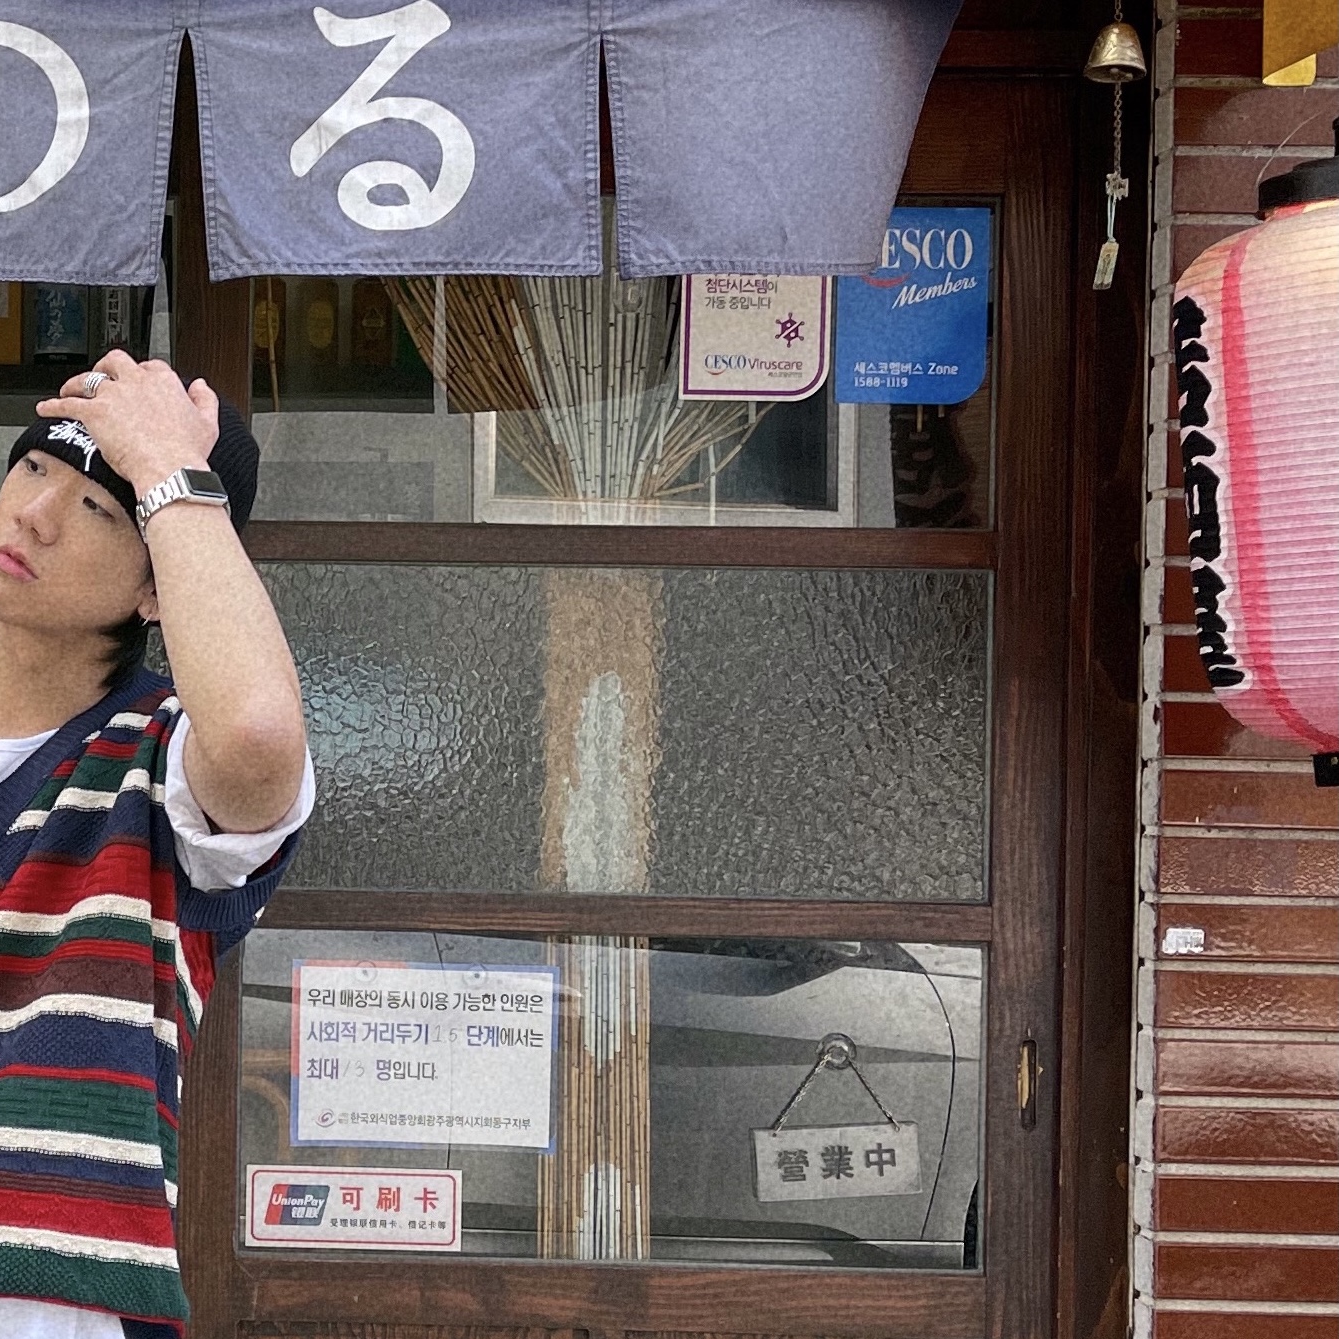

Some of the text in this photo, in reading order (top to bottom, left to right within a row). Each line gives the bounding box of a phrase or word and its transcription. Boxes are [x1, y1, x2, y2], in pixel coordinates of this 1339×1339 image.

[879, 228, 973, 269] ESCO
[705, 278, 778, 294] 첨단시스템이
[891, 272, 978, 309] Members
[704, 296, 771, 310] 가동 중입니다
[704, 354, 803, 371] CESCO Viruscare
[927, 362, 959, 375] Zone
[854, 376, 909, 388] 1588-1119
[307, 988, 544, 1014] 우리 매장의 동시 이용 가능한 인원은
[306, 1021, 357, 1044] 사회적
[361, 1022, 429, 1046] 거리두기
[466, 1025, 544, 1048] 단계에서는
[306, 1058, 339, 1080] 최대
[375, 1058, 439, 1081] 명입니다.
[776, 1142, 897, 1183] 營業中
[271, 1192, 325, 1208] UnionPay
[339, 1186, 440, 1214] 可刷卡
